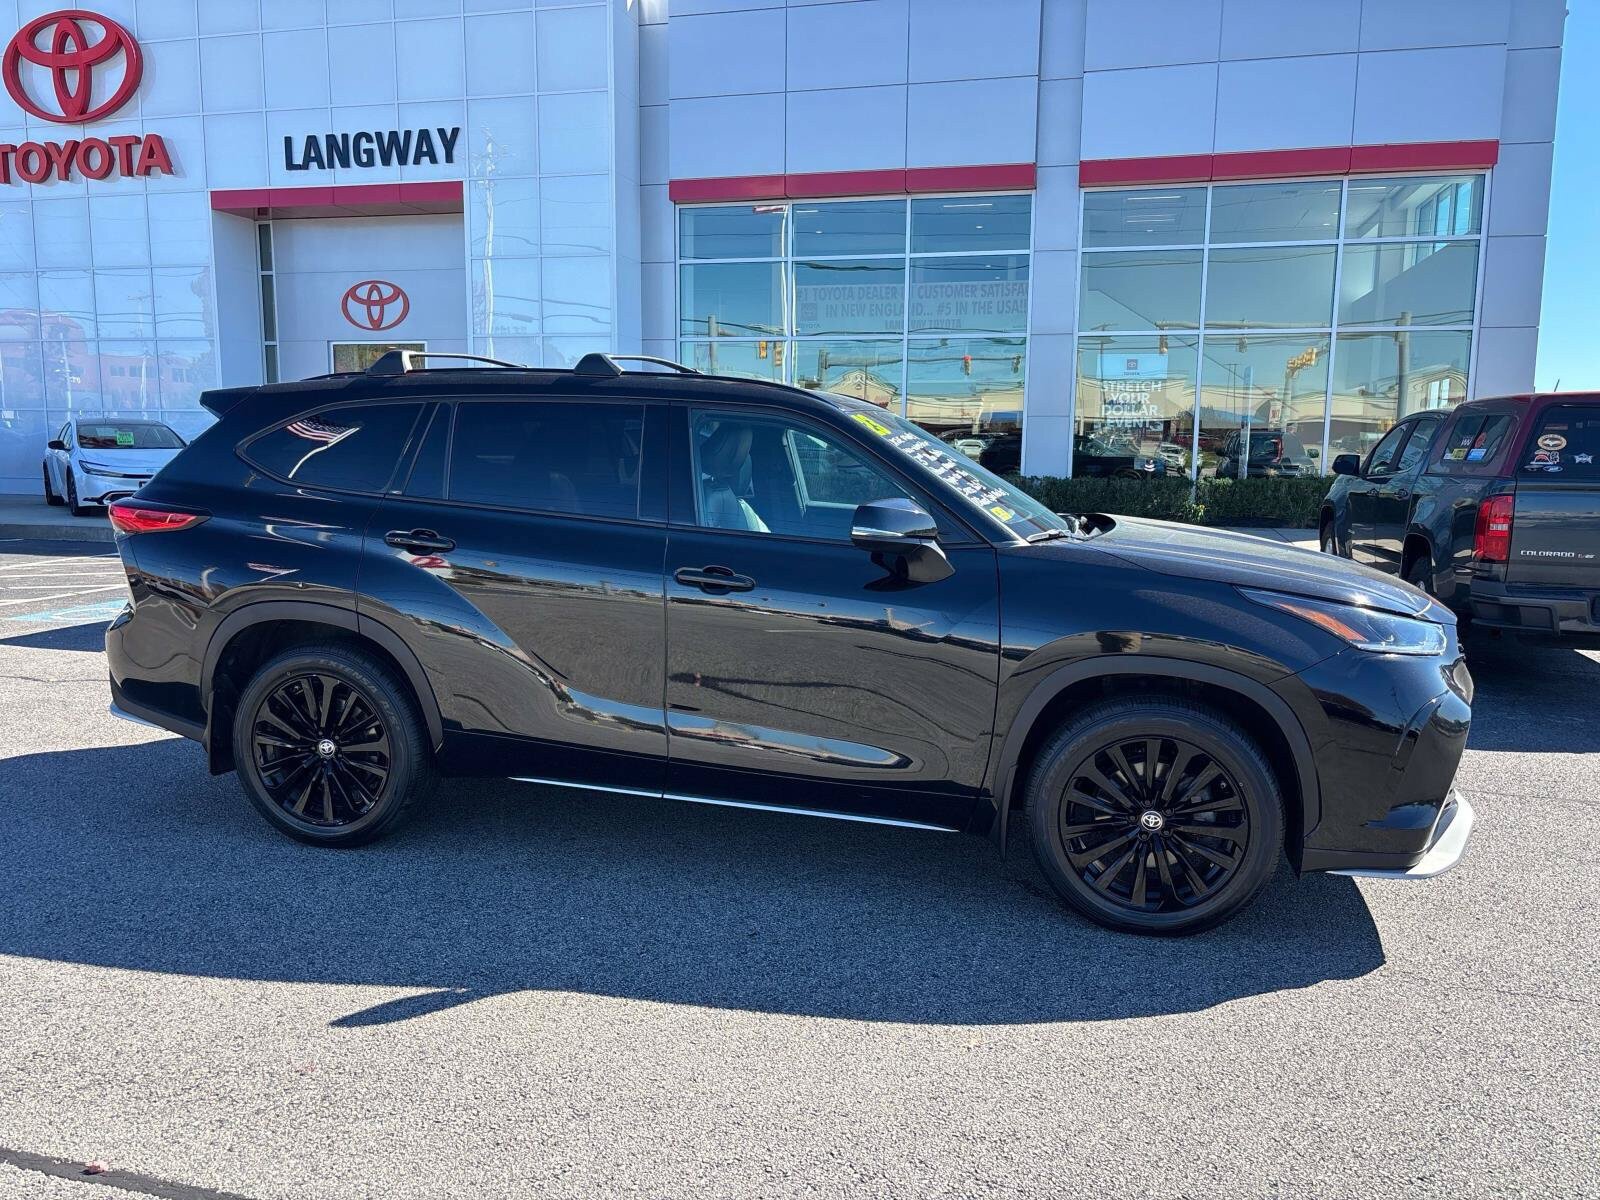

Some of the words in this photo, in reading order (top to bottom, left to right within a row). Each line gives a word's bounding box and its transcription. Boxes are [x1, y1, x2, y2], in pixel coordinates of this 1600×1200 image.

[284, 127, 460, 171] LANGWAY
[0, 134, 175, 184] TOYOTA
[813, 287, 854, 301] TOYOTA
[858, 286, 898, 300] DEALER
[917, 284, 976, 299] CUSTOMER
[825, 303, 838, 318] IN
[841, 303, 866, 318] NEW
[937, 302, 952, 316] #5
[955, 301, 968, 315] IN
[971, 300, 993, 315] THE
[929, 318, 963, 329] TOYOTA
[1101, 380, 1162, 392] STRETCH
[1110, 392, 1151, 404] YOUR
[1101, 404, 1159, 416] DOLLAR
[1520, 550, 1576, 558] COLORADO
